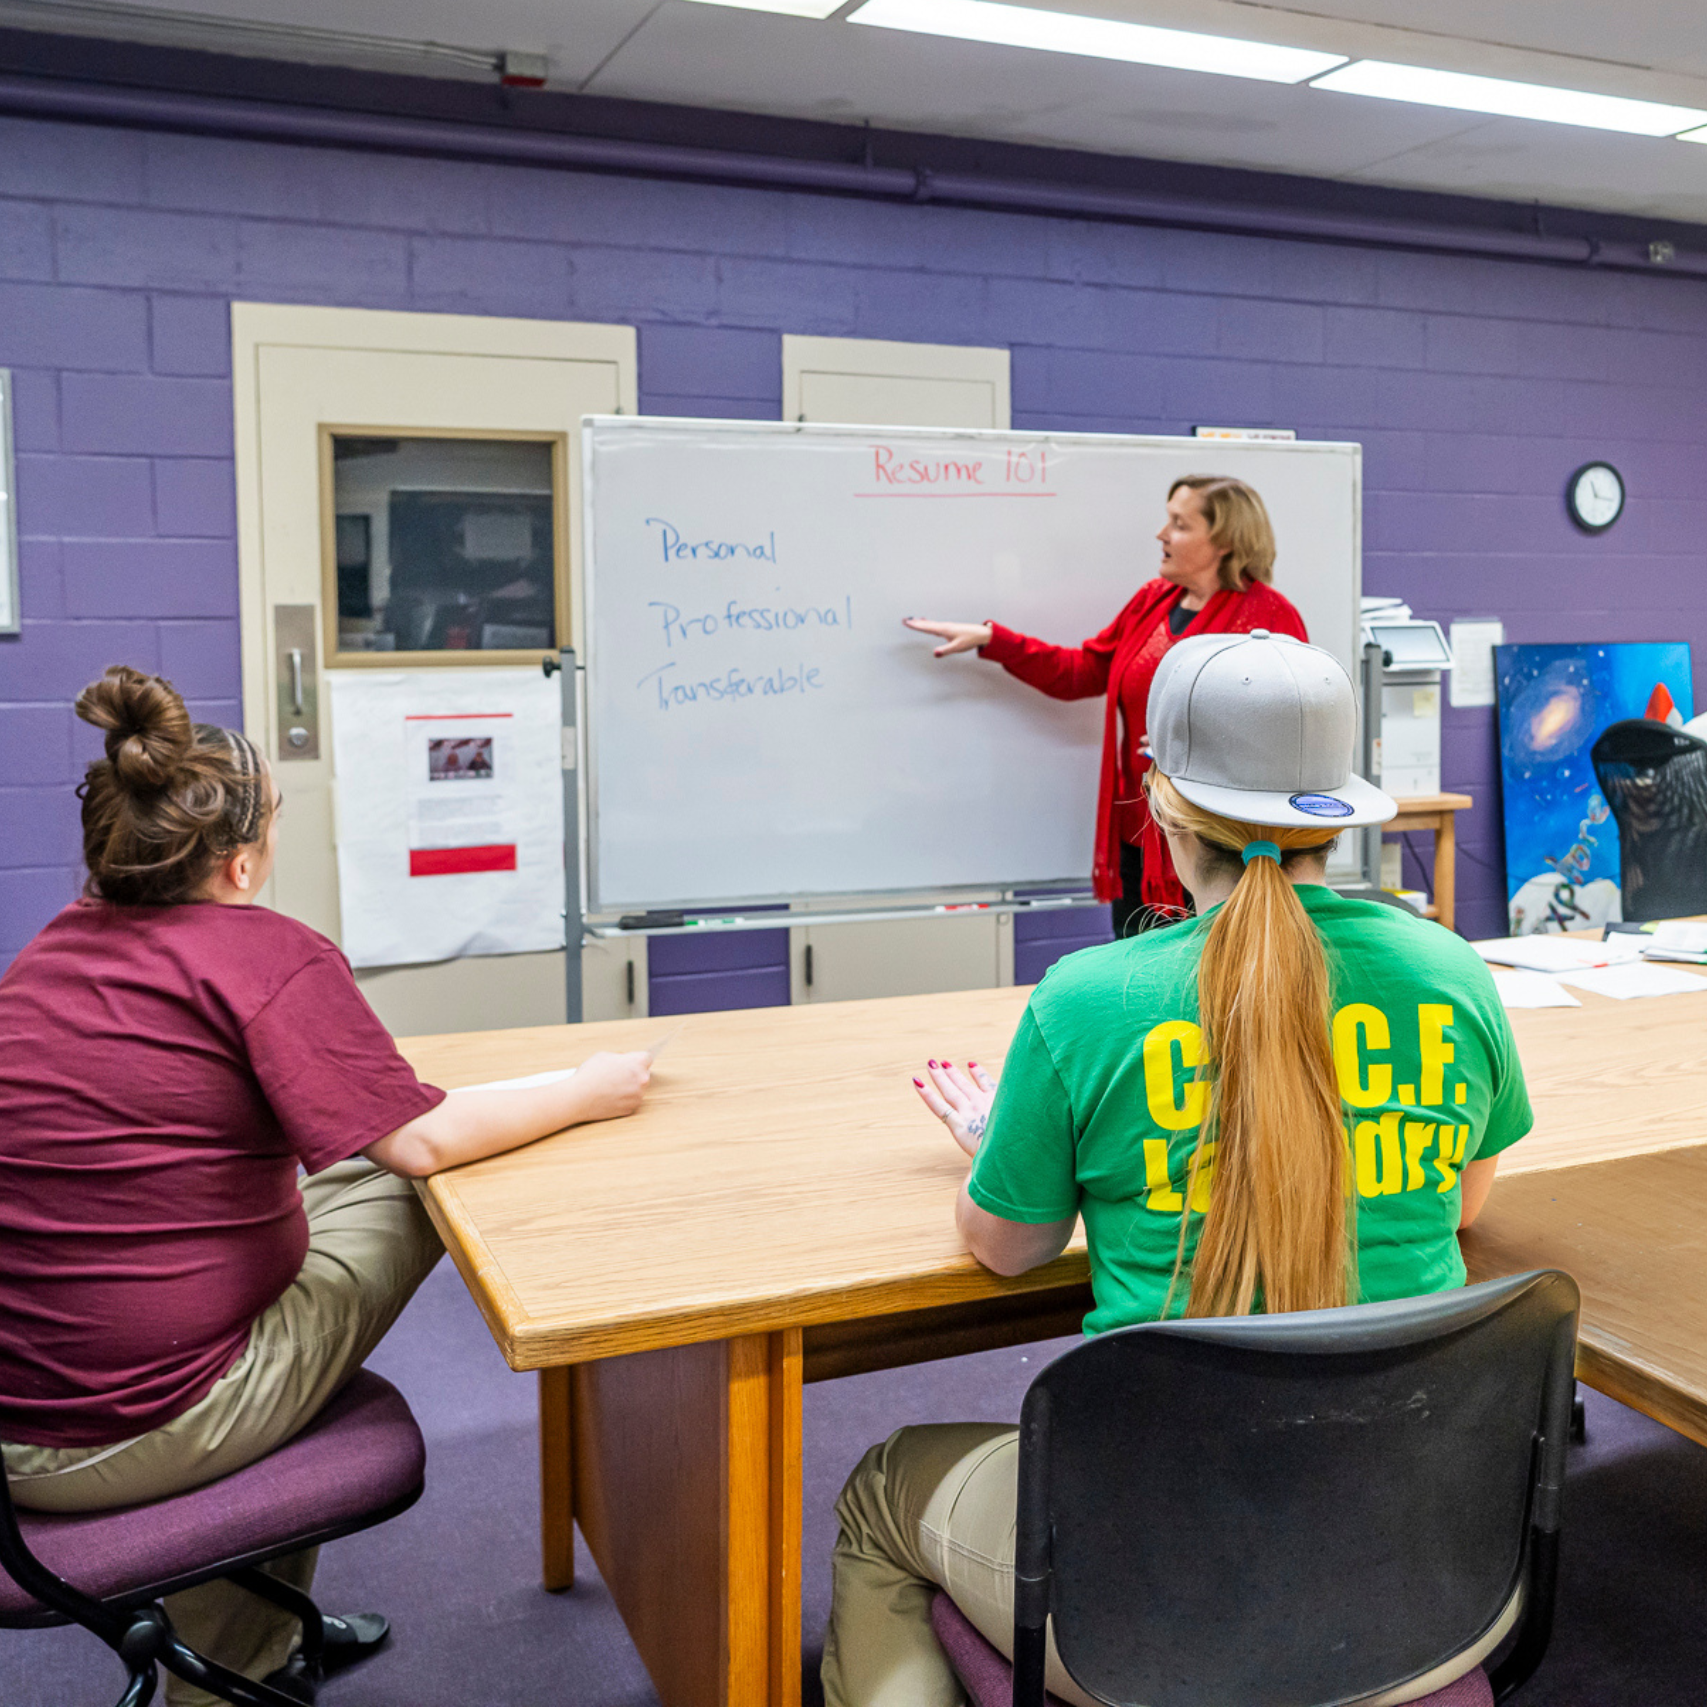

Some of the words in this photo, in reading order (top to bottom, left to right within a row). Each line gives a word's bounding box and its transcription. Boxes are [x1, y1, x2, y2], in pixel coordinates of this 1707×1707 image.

[868, 444, 985, 485] Resume
[1005, 449, 1047, 484] 101
[645, 517, 777, 564] Personal
[648, 595, 852, 648] Professional
[637, 661, 824, 711] Transferable
